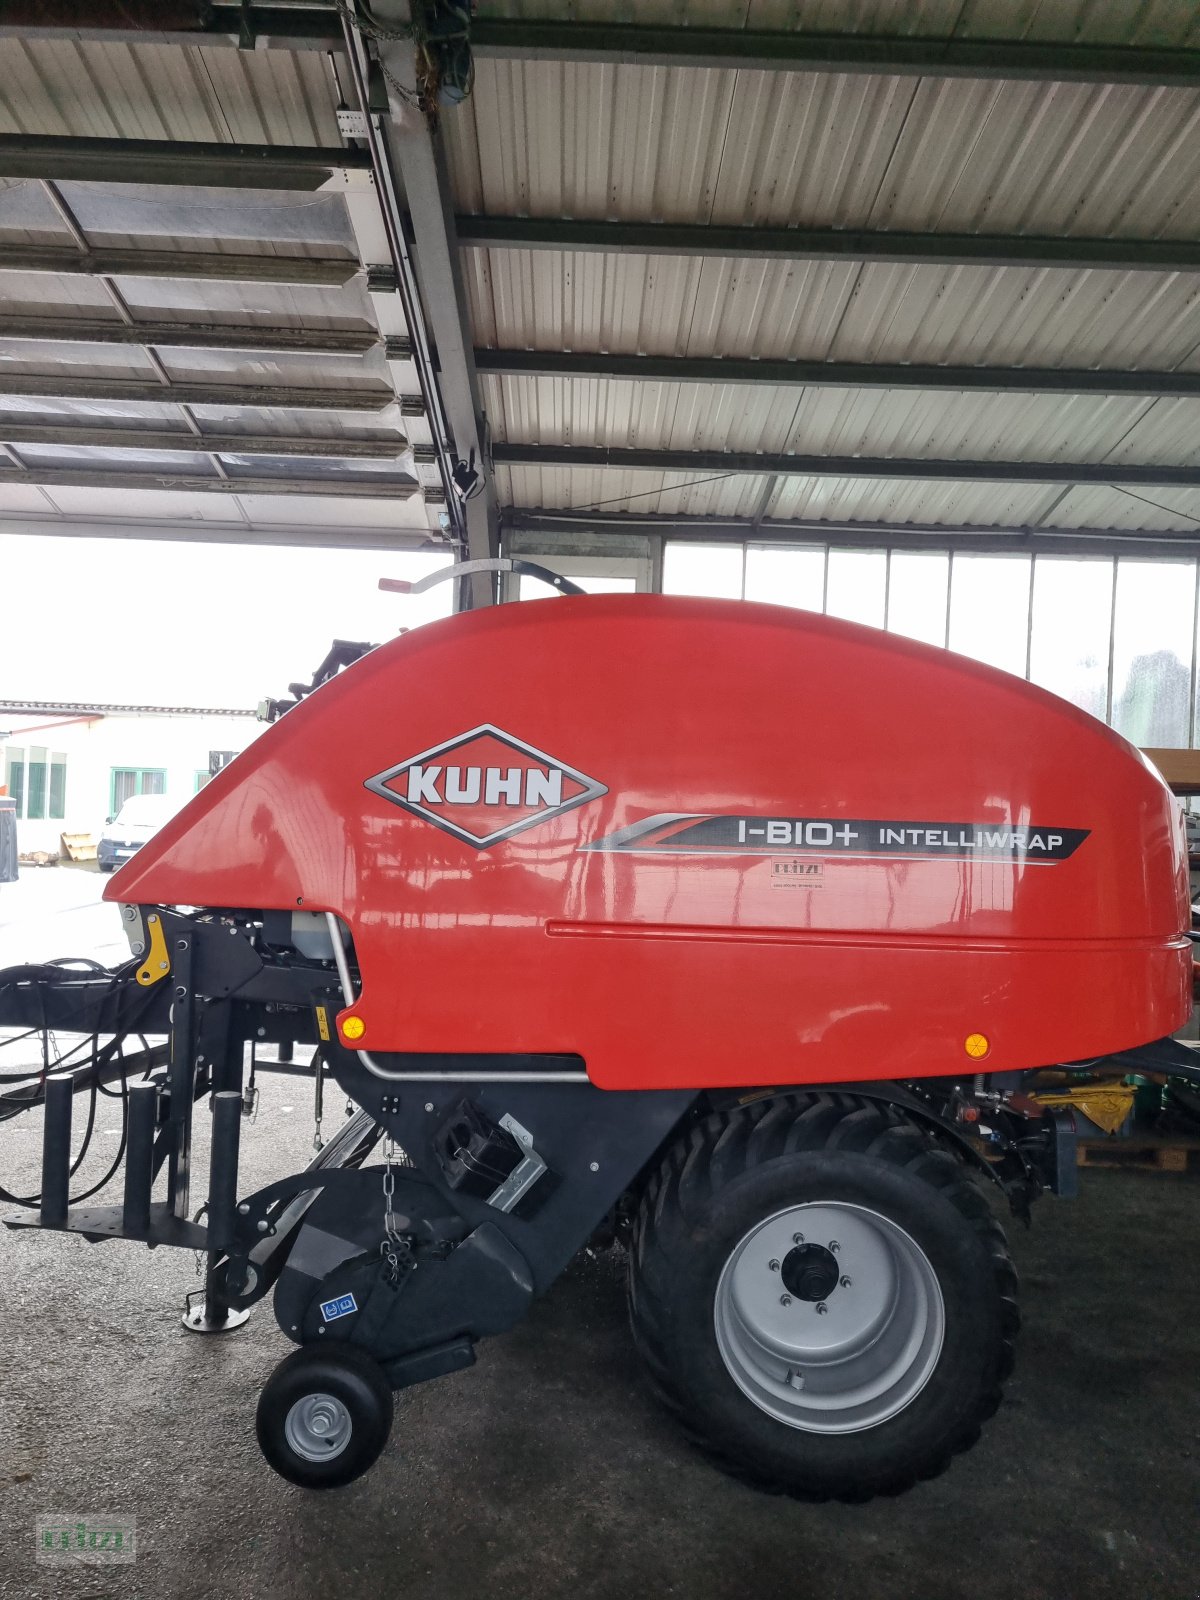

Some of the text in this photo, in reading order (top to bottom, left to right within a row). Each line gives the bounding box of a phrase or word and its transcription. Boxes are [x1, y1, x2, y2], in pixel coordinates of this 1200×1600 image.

[407, 765, 562, 807] KUHN
[738, 820, 1063, 850] I-BIO+ INTELLIWRAP
